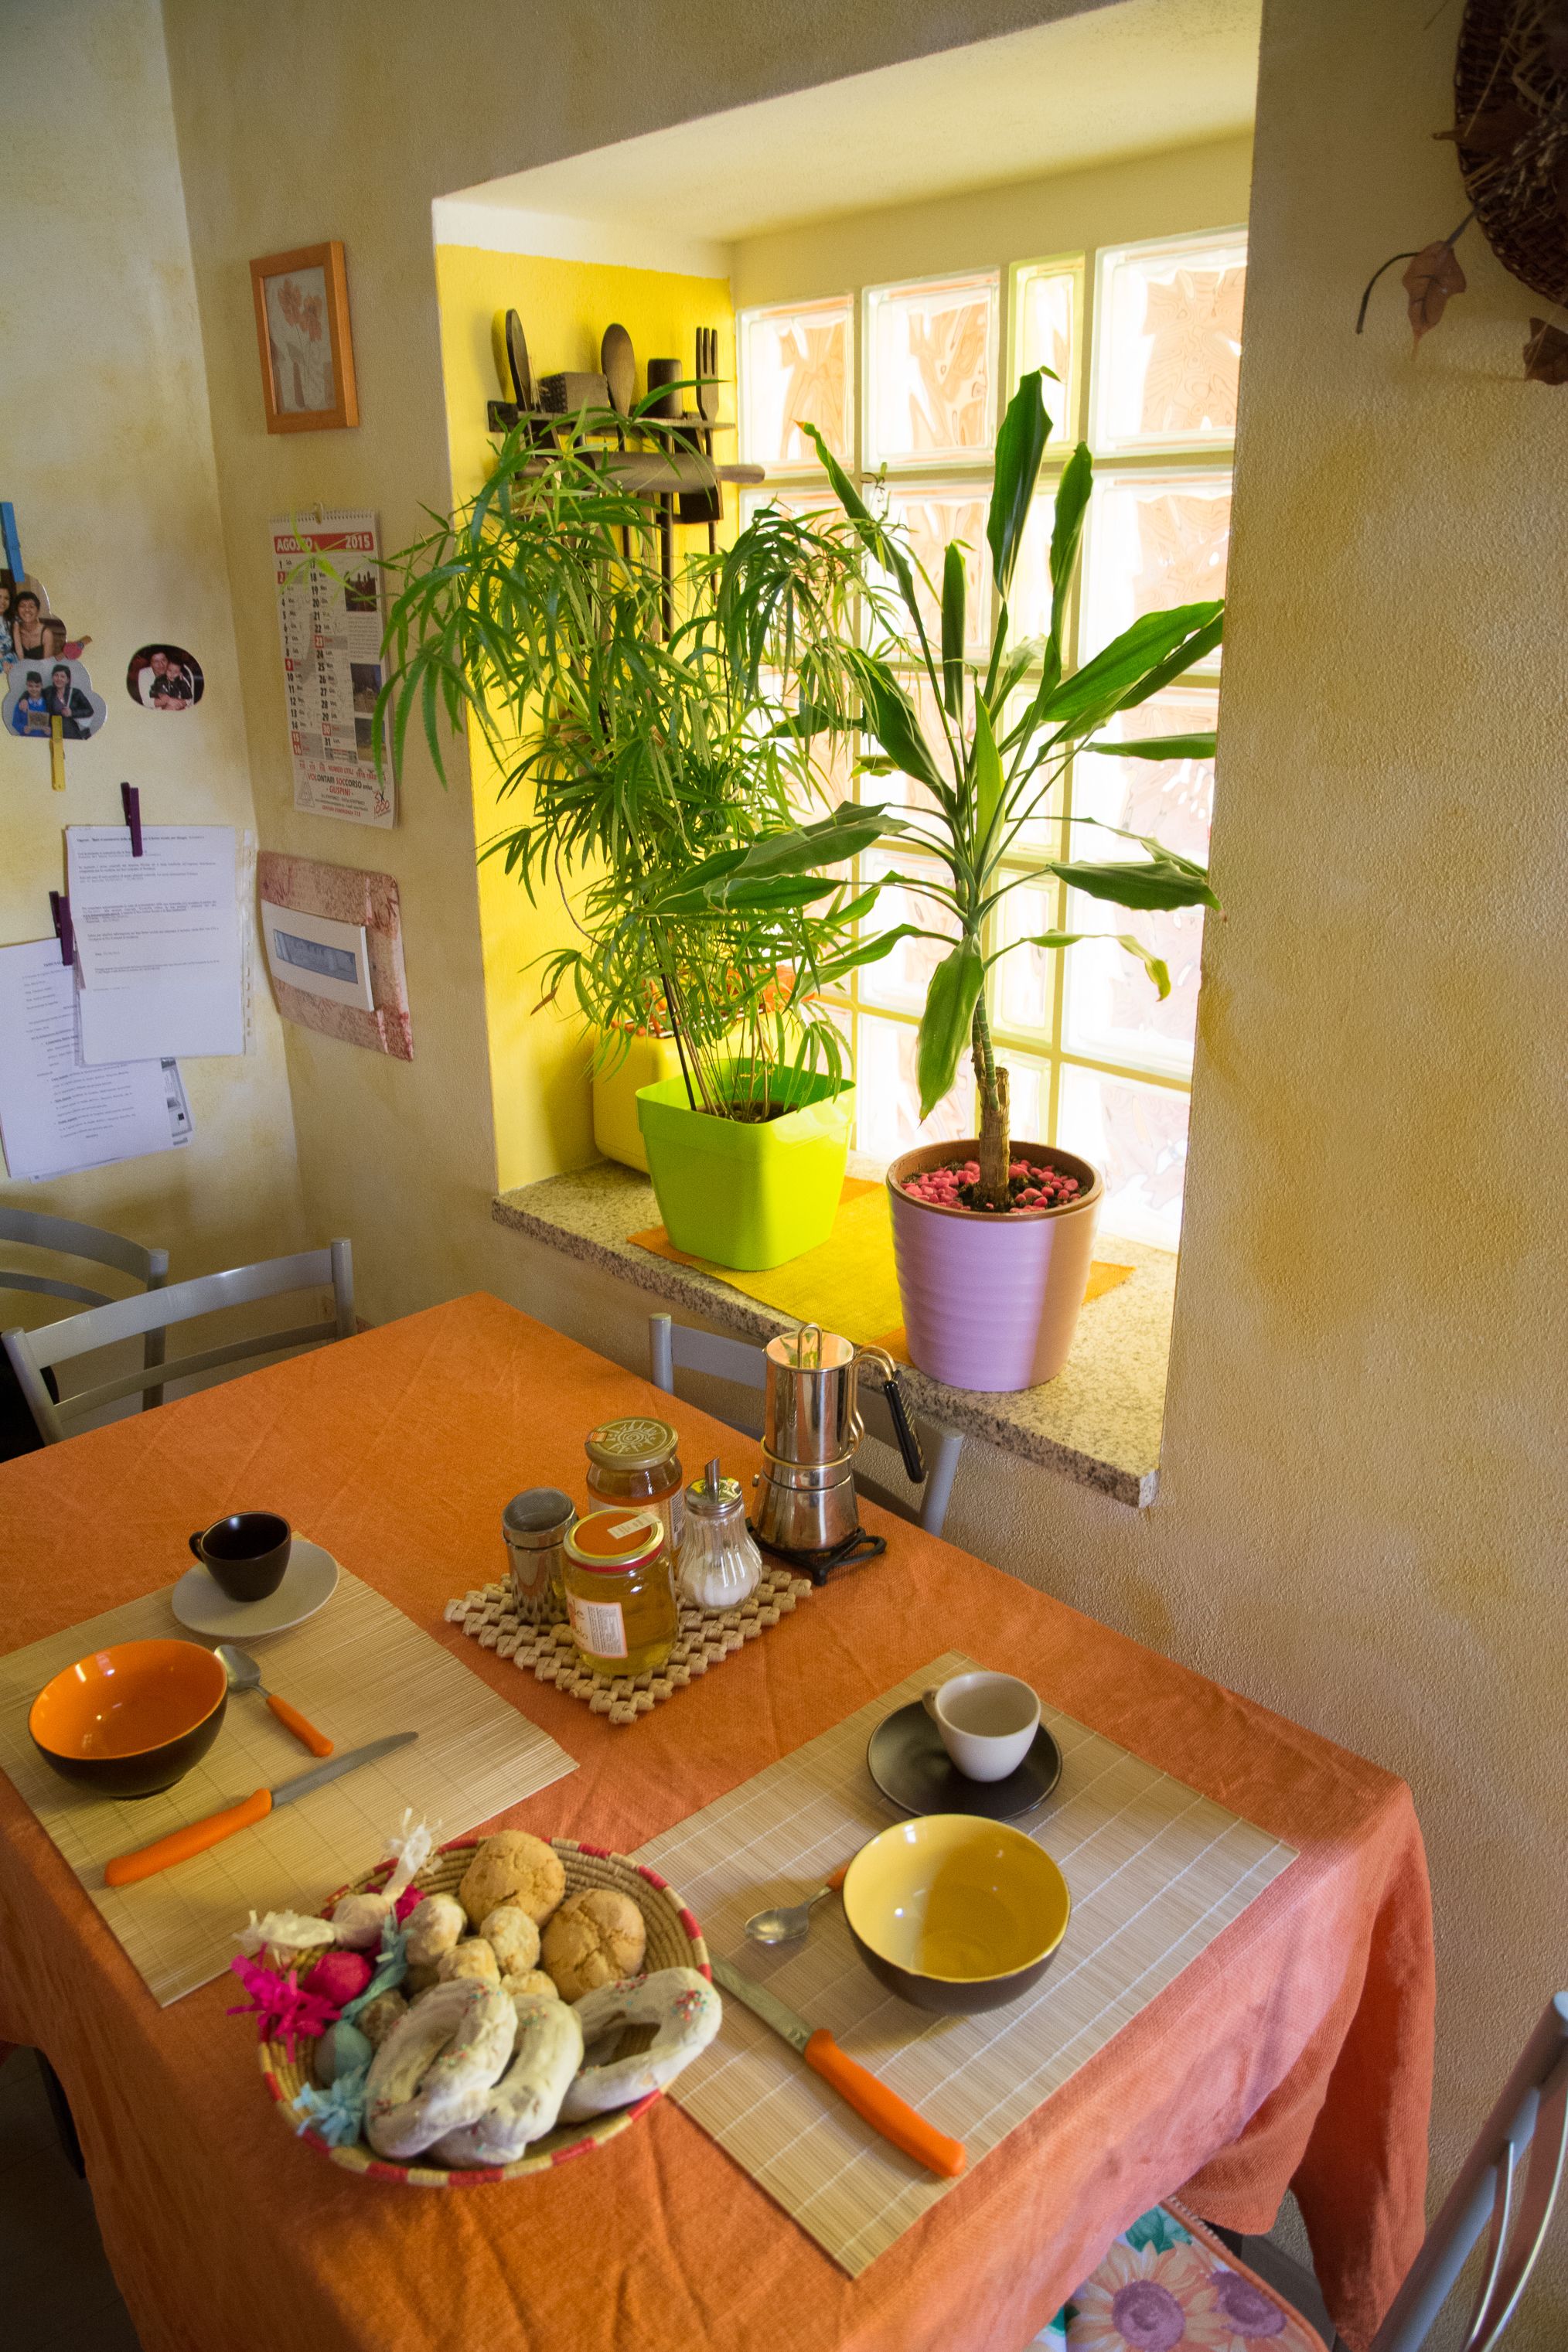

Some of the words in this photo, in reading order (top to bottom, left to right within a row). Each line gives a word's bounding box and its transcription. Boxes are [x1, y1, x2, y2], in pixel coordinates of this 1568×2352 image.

[277, 537, 313, 552] AGOSO
[346, 533, 370, 549] 2015
[311, 572, 318, 582] 18
[312, 585, 319, 595] 19
[312, 598, 320, 608] 20
[313, 611, 320, 621] 21
[315, 624, 322, 633] 22
[315, 636, 323, 647] 23
[317, 649, 324, 659] 24
[318, 662, 325, 672] 25
[287, 673, 294, 682] 10
[319, 675, 326, 684] 26
[288, 685, 295, 694] 11
[320, 687, 327, 697] 27
[290, 697, 296, 706] 12
[321, 700, 328, 710] 28
[291, 708, 297, 718] 13
[322, 712, 329, 721] 29
[291, 721, 298, 730] 14
[322, 725, 330, 735] 30
[292, 733, 299, 742] 15
[324, 737, 331, 746] 31
[294, 745, 302, 754] 16
[308, 772, 335, 783] VOLONTARI
[336, 776, 362, 789] SOCCORSO
[329, 786, 351, 796] GUSPINI
[373, 800, 390, 815] 1000
